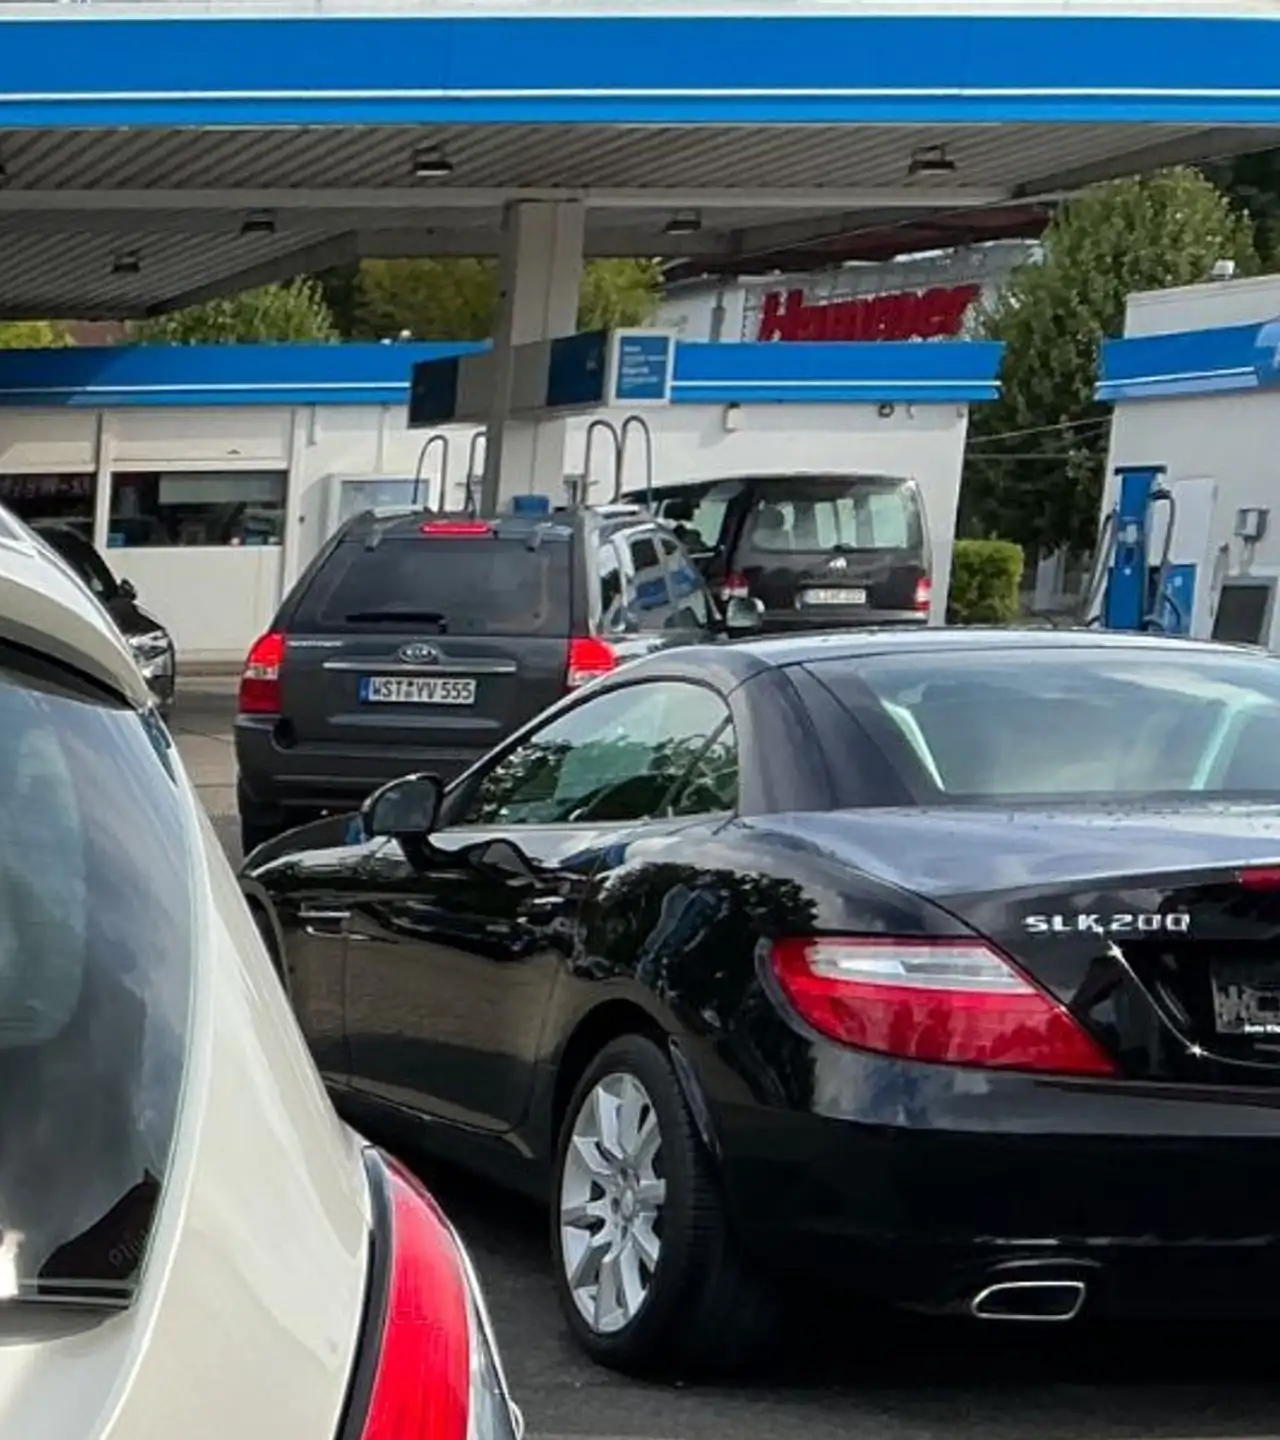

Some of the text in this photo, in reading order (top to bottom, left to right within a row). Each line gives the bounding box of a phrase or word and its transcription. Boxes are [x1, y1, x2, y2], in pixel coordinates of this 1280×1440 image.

[440, 681, 473, 701] 555
[1024, 913, 1190, 933] SLK 200
